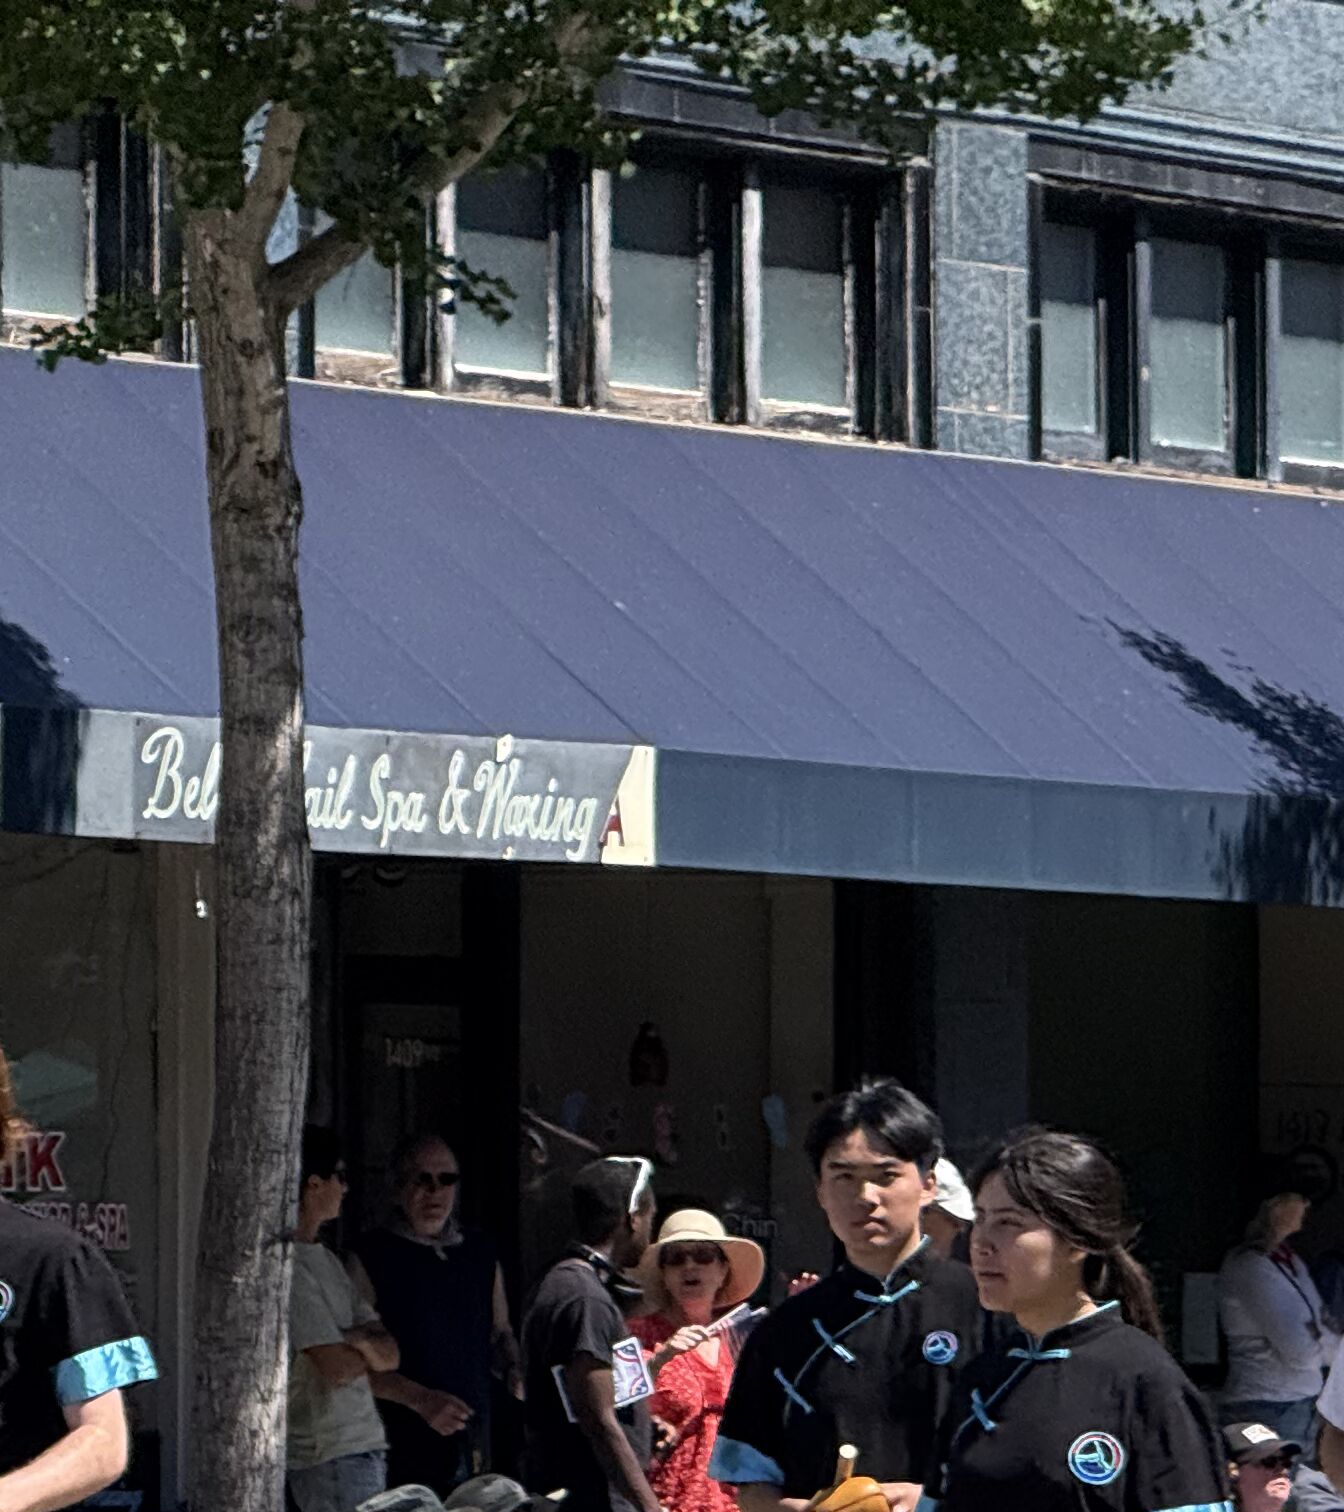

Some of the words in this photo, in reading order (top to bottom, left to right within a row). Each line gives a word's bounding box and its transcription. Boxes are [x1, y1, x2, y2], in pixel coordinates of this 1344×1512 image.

[141, 726, 222, 820] Bel
[303, 741, 357, 830] ail
[361, 753, 428, 848] Spa
[438, 750, 471, 834] &
[473, 752, 599, 863] Waxing
